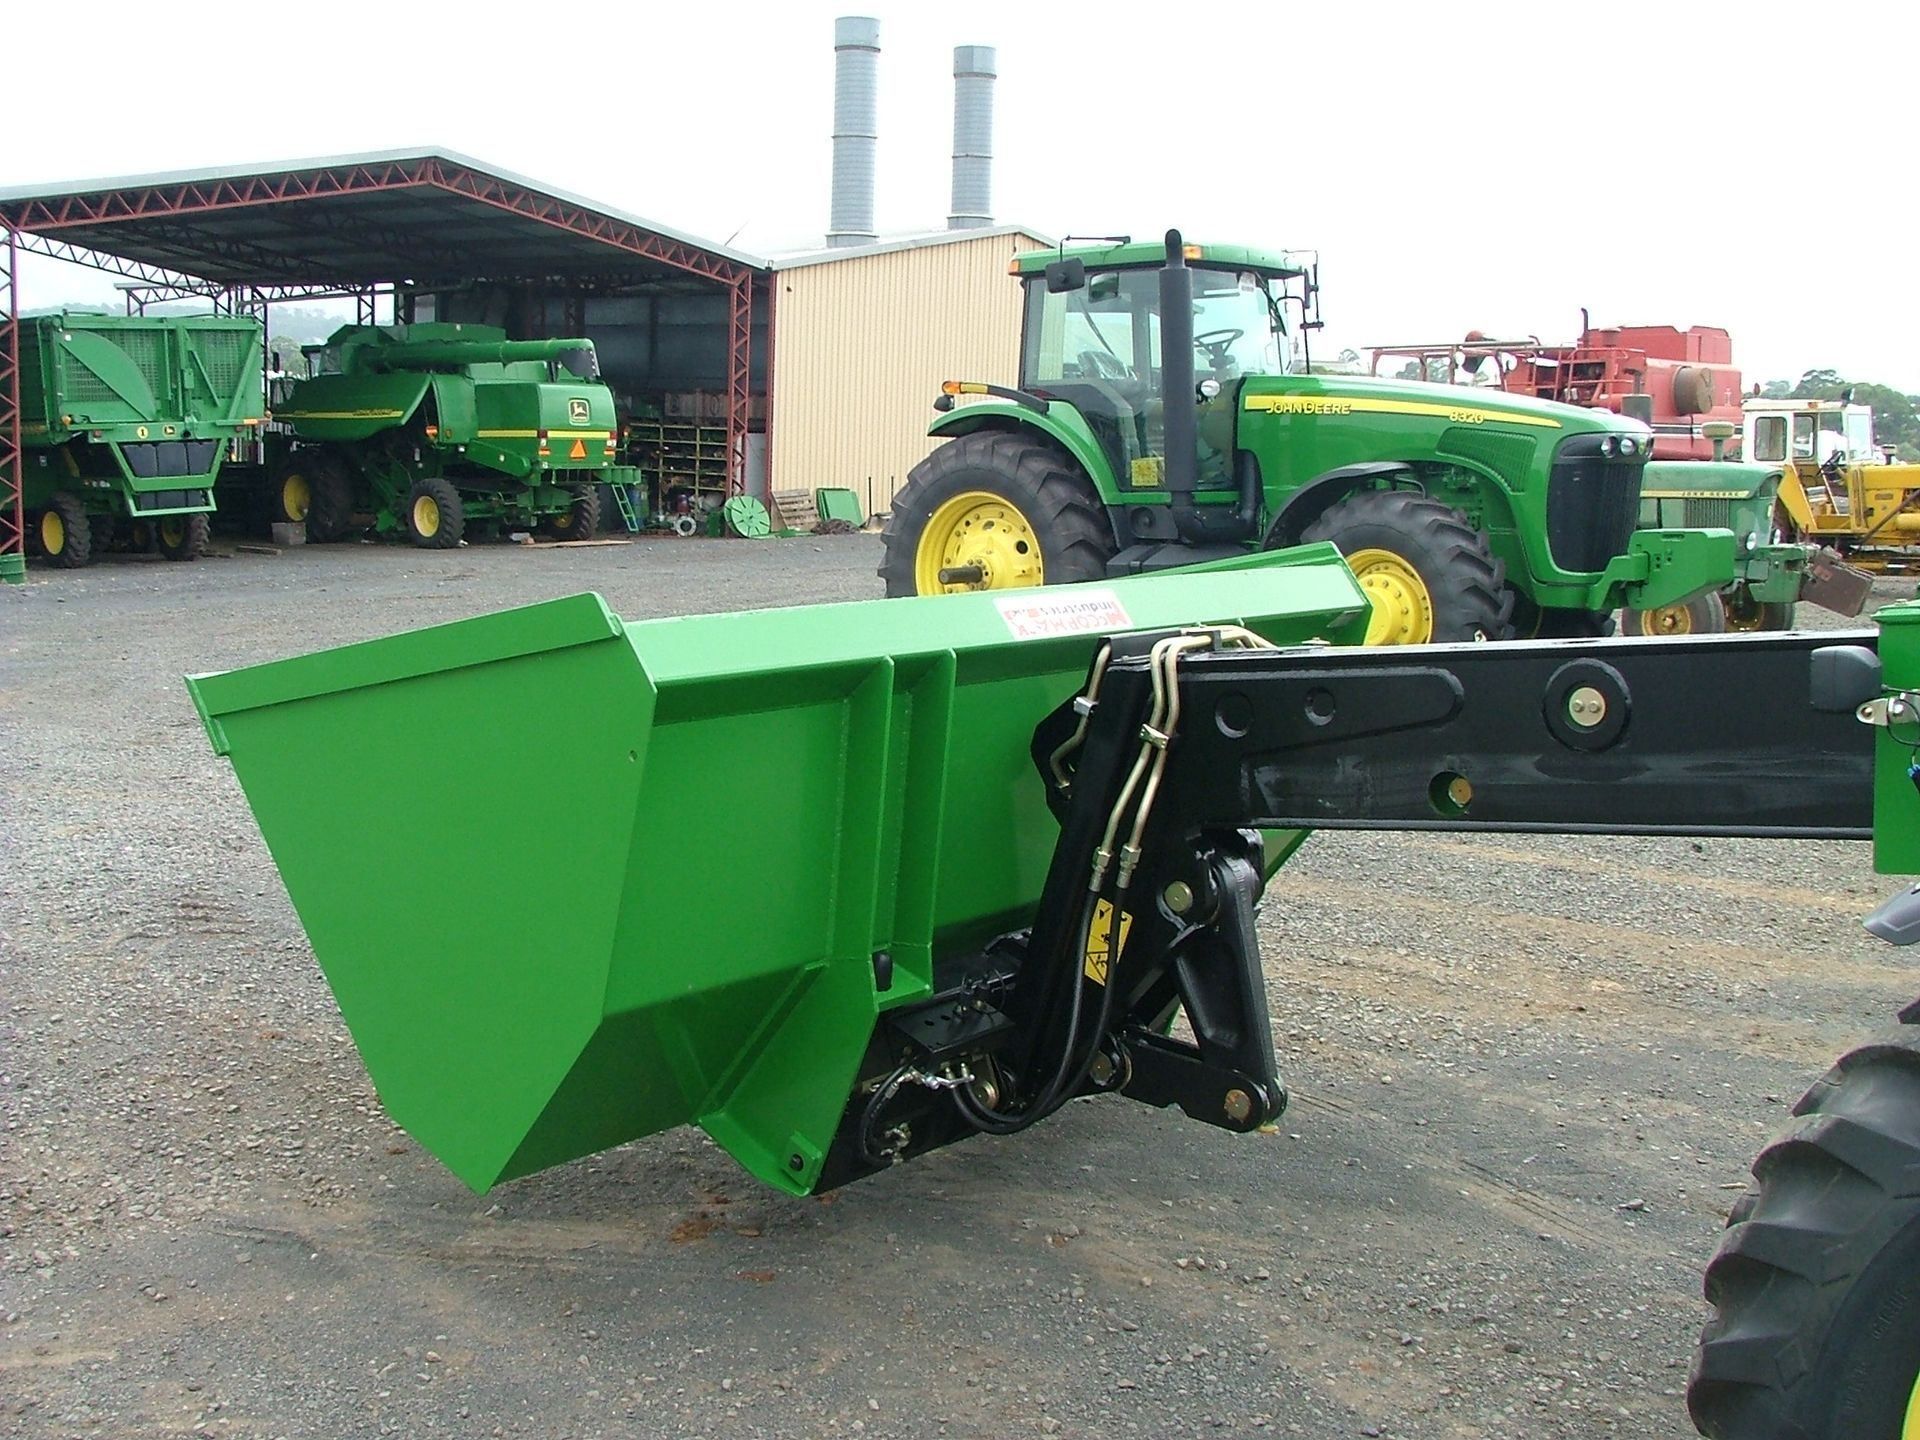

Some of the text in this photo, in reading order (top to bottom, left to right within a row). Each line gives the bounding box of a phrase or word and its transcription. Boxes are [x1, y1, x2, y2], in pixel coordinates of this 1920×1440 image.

[1265, 401, 1351, 415] JOHN DEERE
[1449, 410, 1484, 425] 8320
